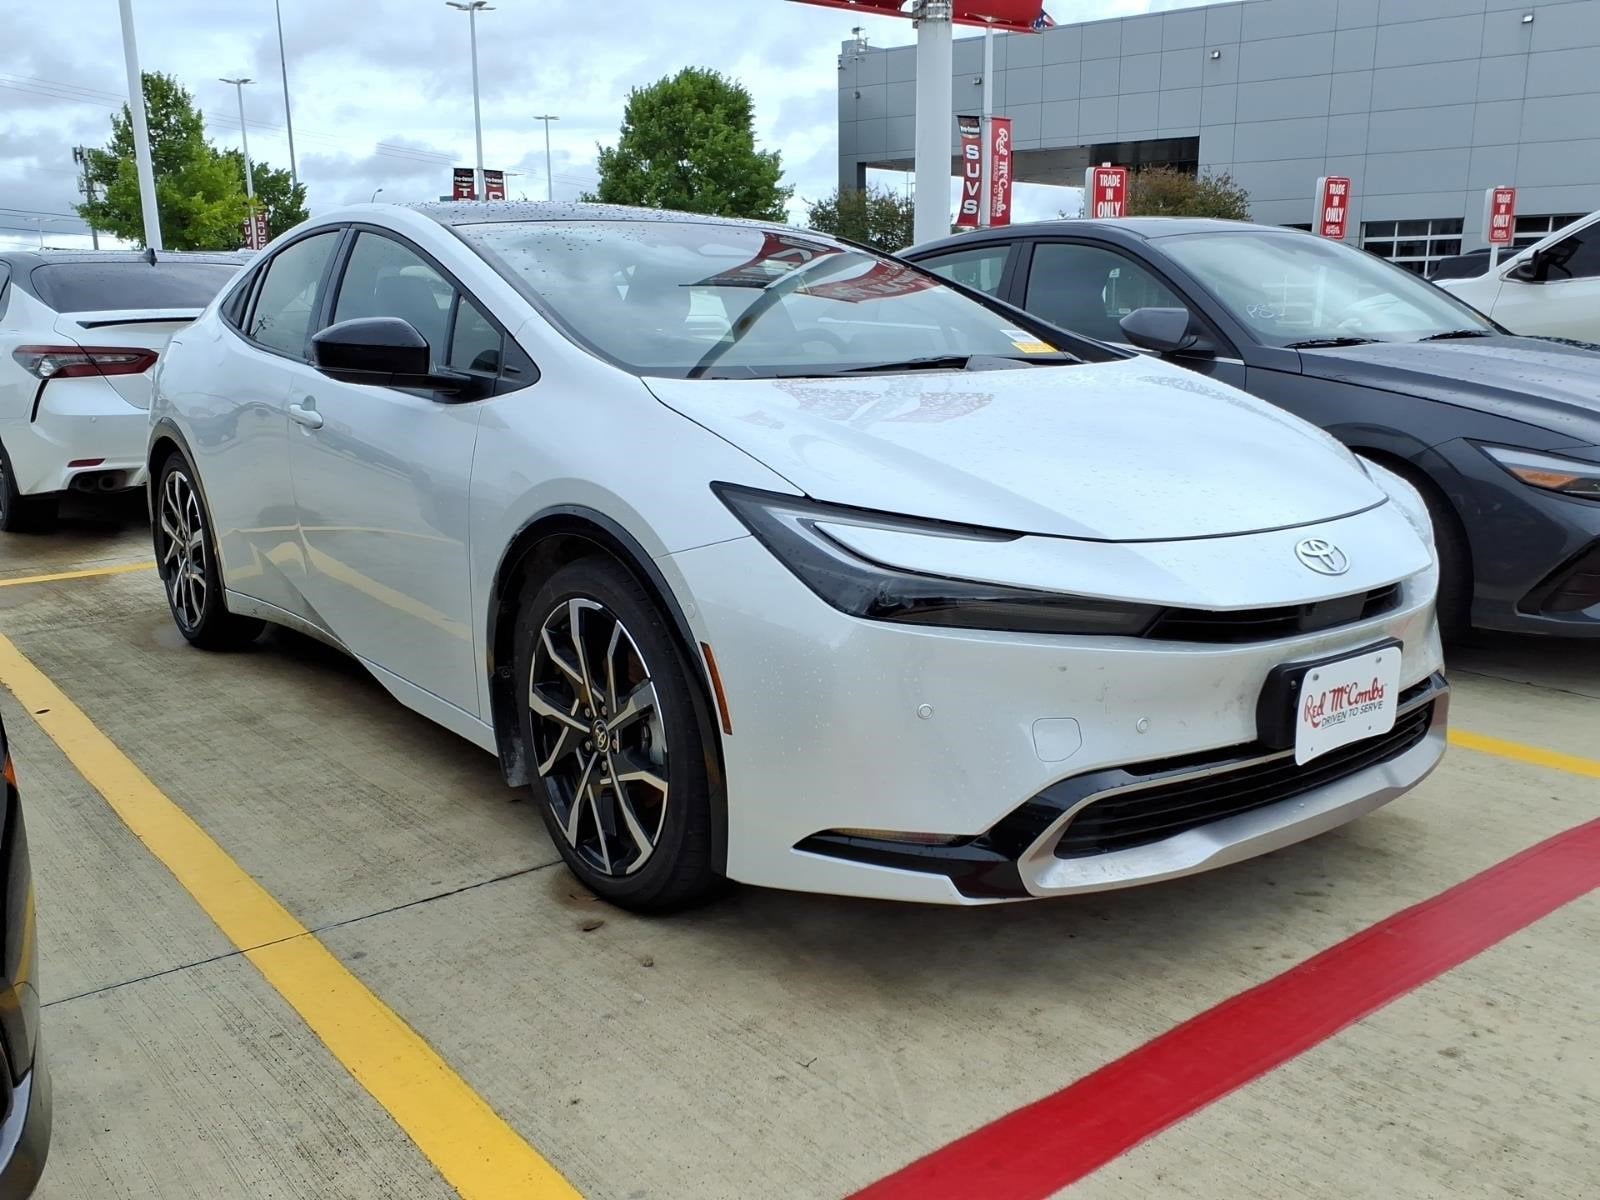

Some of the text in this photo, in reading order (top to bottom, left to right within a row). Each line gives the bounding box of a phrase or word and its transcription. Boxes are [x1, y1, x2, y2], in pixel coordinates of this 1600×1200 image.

[996, 128, 1008, 156] Red
[963, 144, 980, 214] SUVS
[995, 157, 1008, 217] McCombs
[1100, 174, 1121, 187] TRADE
[1329, 183, 1346, 195] TRADE
[1105, 188, 1114, 201] IN
[1097, 201, 1122, 218] ONLY
[1325, 207, 1345, 223] ONLY
[1304, 677, 1384, 728] Red McCombs
[1321, 700, 1384, 728] DRIVEN TO SERVE
